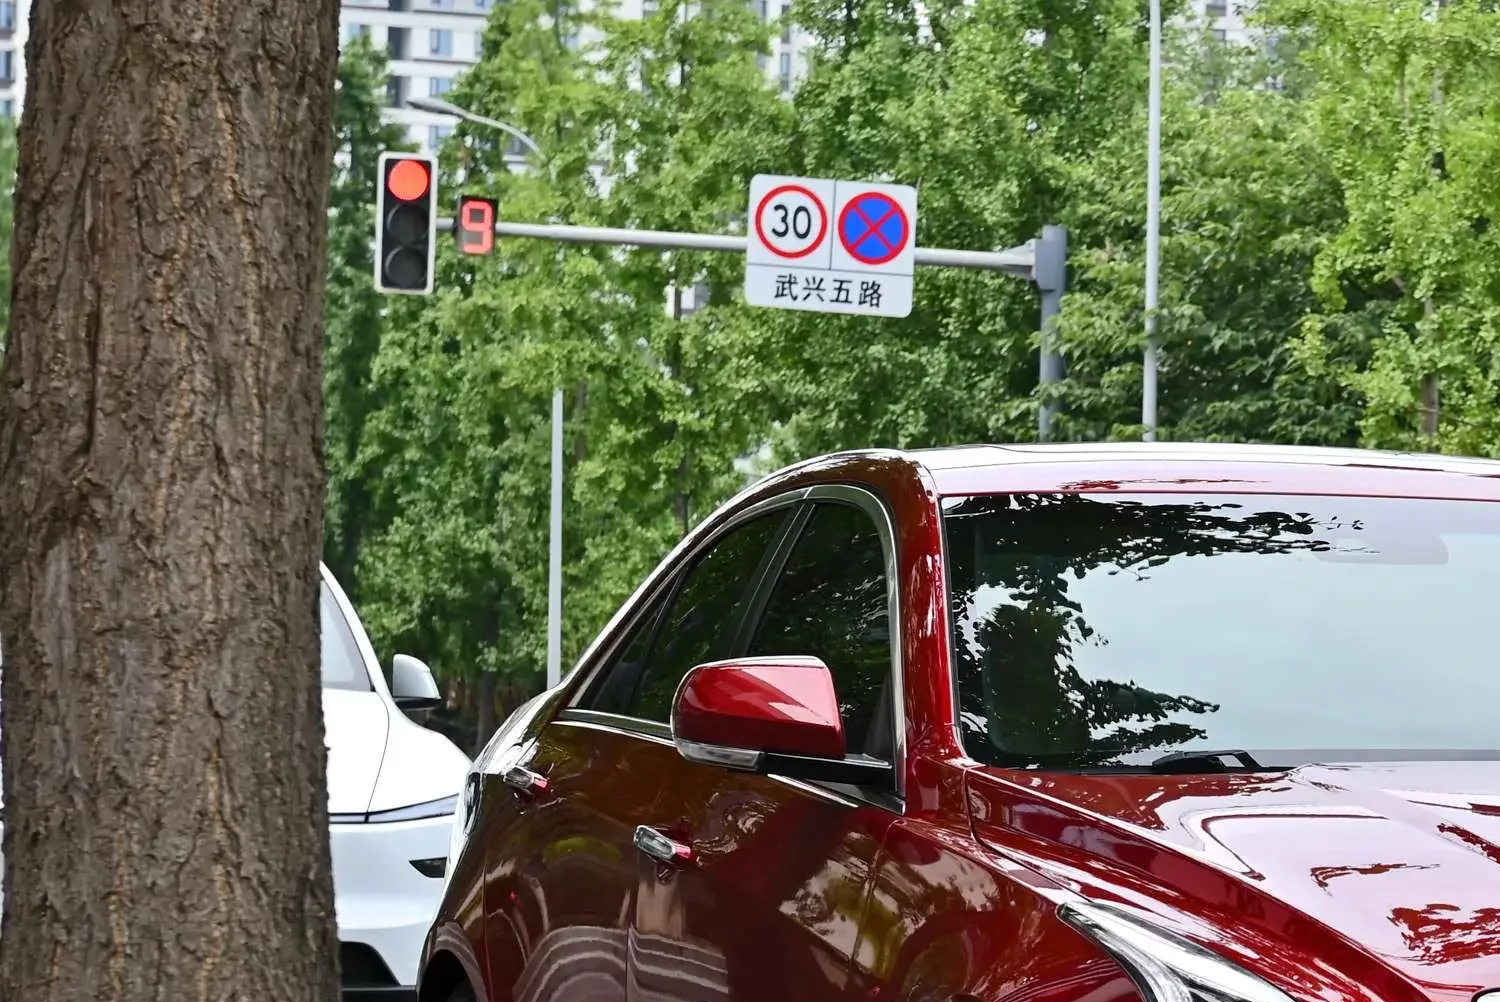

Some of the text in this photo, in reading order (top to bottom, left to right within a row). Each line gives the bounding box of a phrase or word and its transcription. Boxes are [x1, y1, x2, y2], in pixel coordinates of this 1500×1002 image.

[462, 200, 492, 254] 9
[772, 204, 811, 239] 30
[774, 273, 882, 308] 武兴五路
